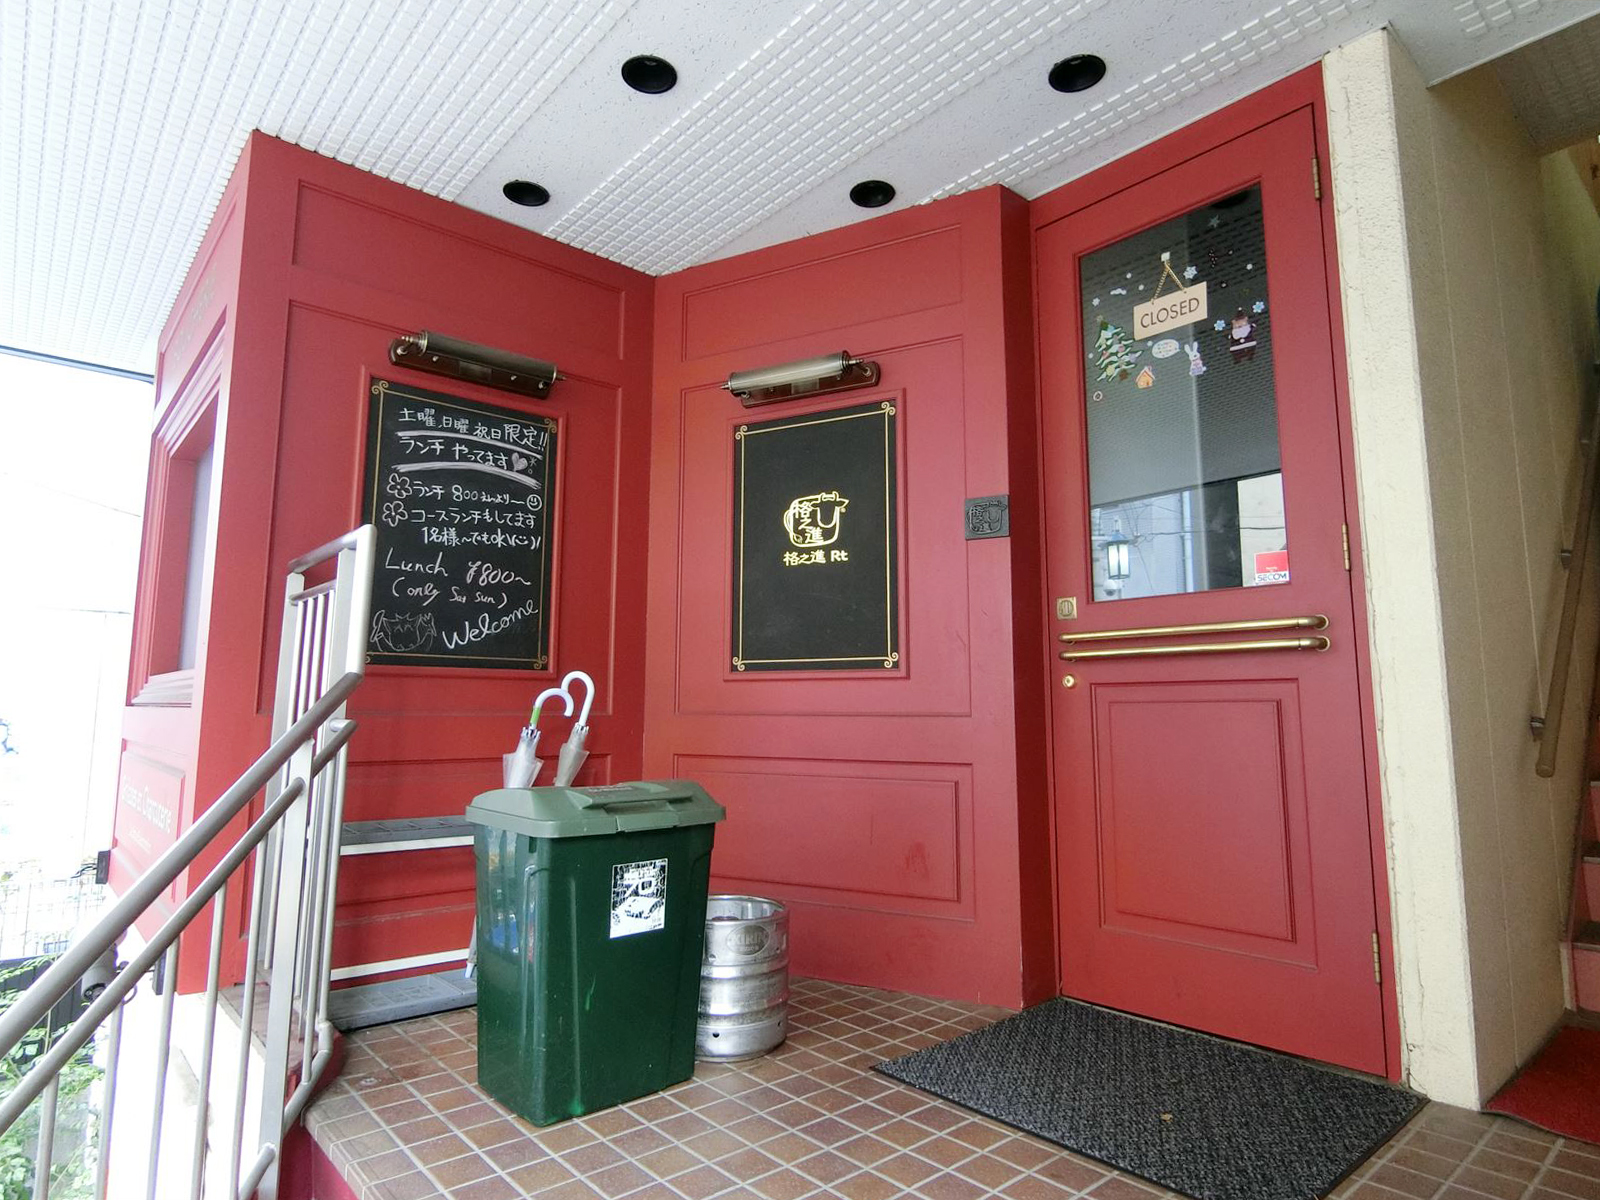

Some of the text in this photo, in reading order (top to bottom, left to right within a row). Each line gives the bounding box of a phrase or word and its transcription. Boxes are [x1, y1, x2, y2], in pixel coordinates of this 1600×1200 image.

[1140, 297, 1200, 329] CLOSED
[385, 547, 448, 576] Lunch
[783, 550, 849, 566] 格之進 Rt
[1257, 573, 1287, 582] SECOM
[442, 599, 539, 649] Welcome
